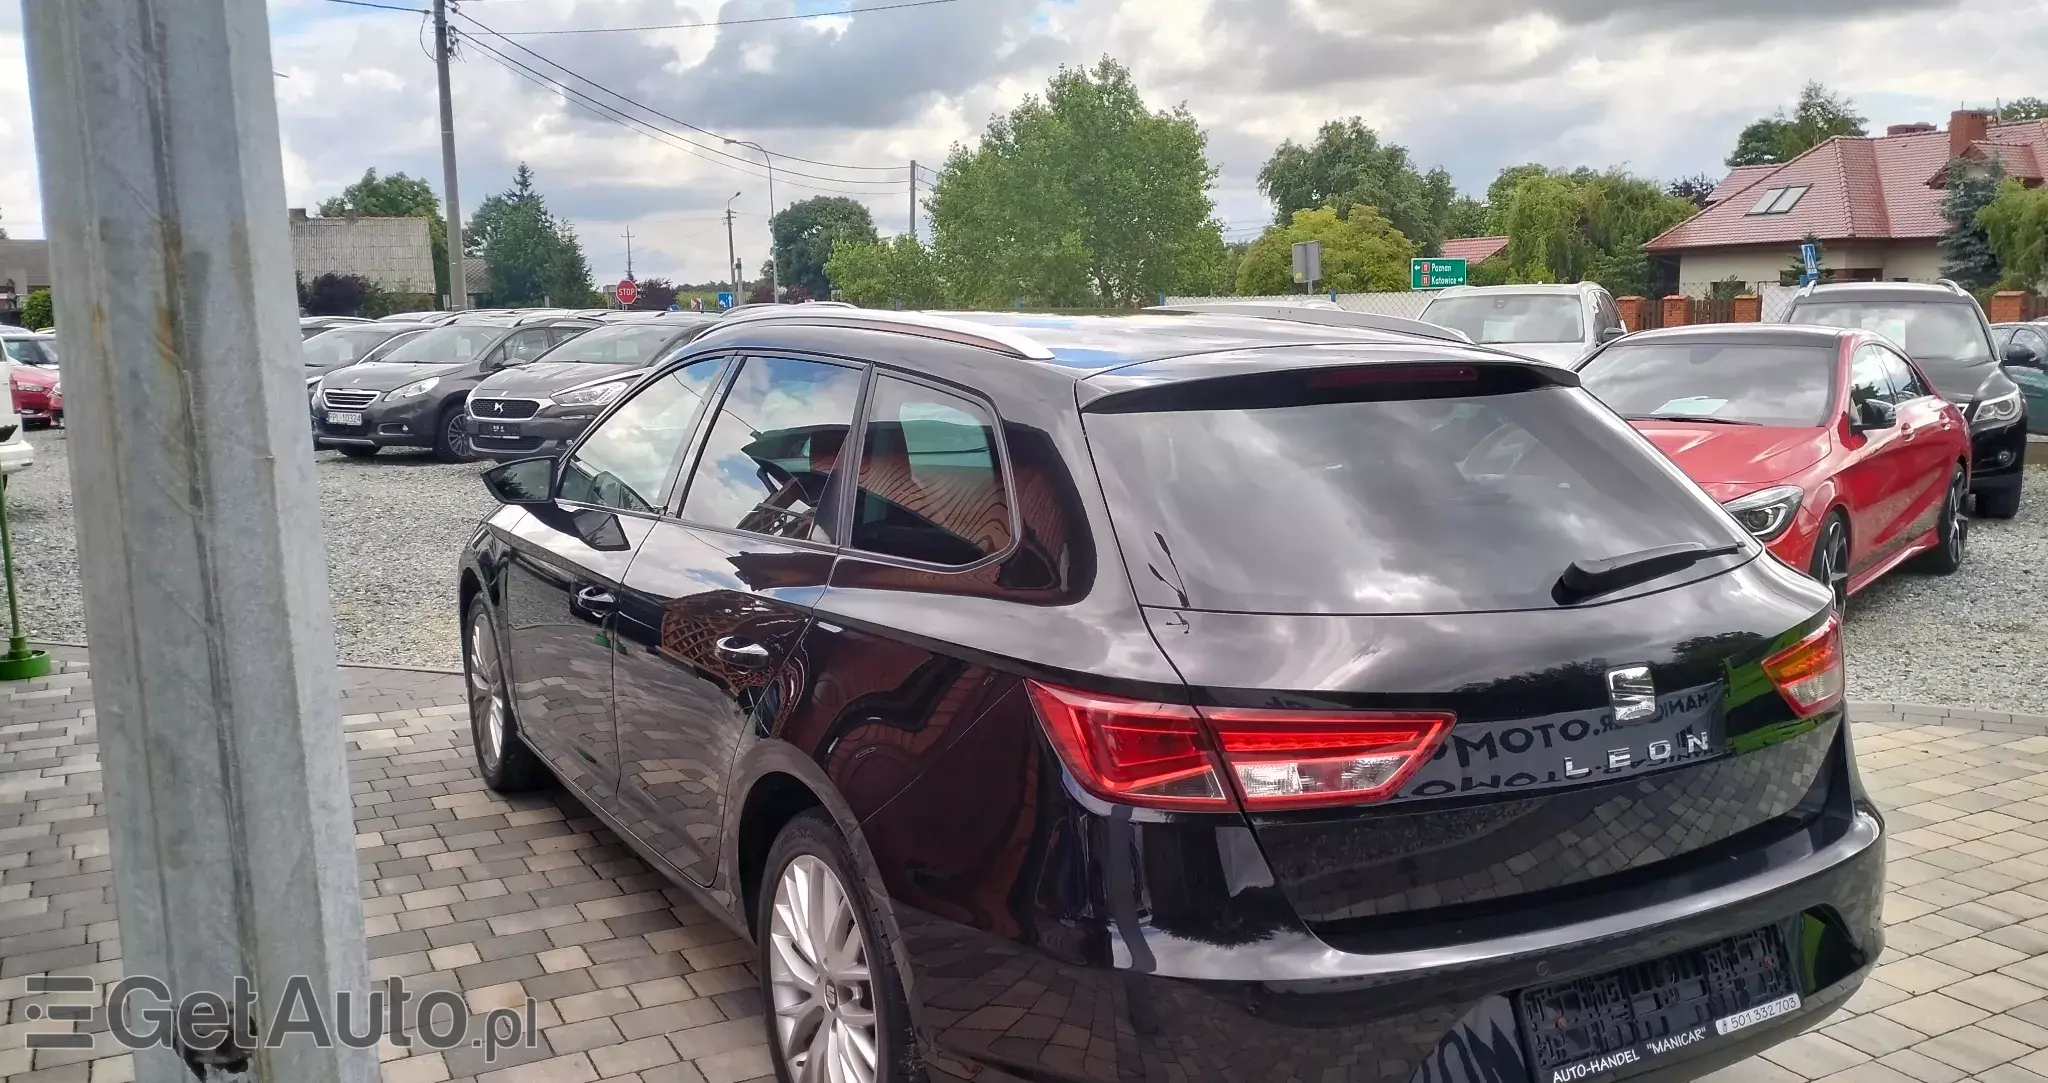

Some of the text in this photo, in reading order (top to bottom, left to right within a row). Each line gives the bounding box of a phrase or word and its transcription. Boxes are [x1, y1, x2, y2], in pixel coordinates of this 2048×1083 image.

[1431, 263, 1452, 272] Poznań
[1431, 276, 1457, 285] Katowice
[618, 288, 635, 296] STOP
[1564, 731, 1709, 776] LEON
[1552, 997, 1797, 1083] AUTO-HANDEL "MANICAR" 501 332 703
